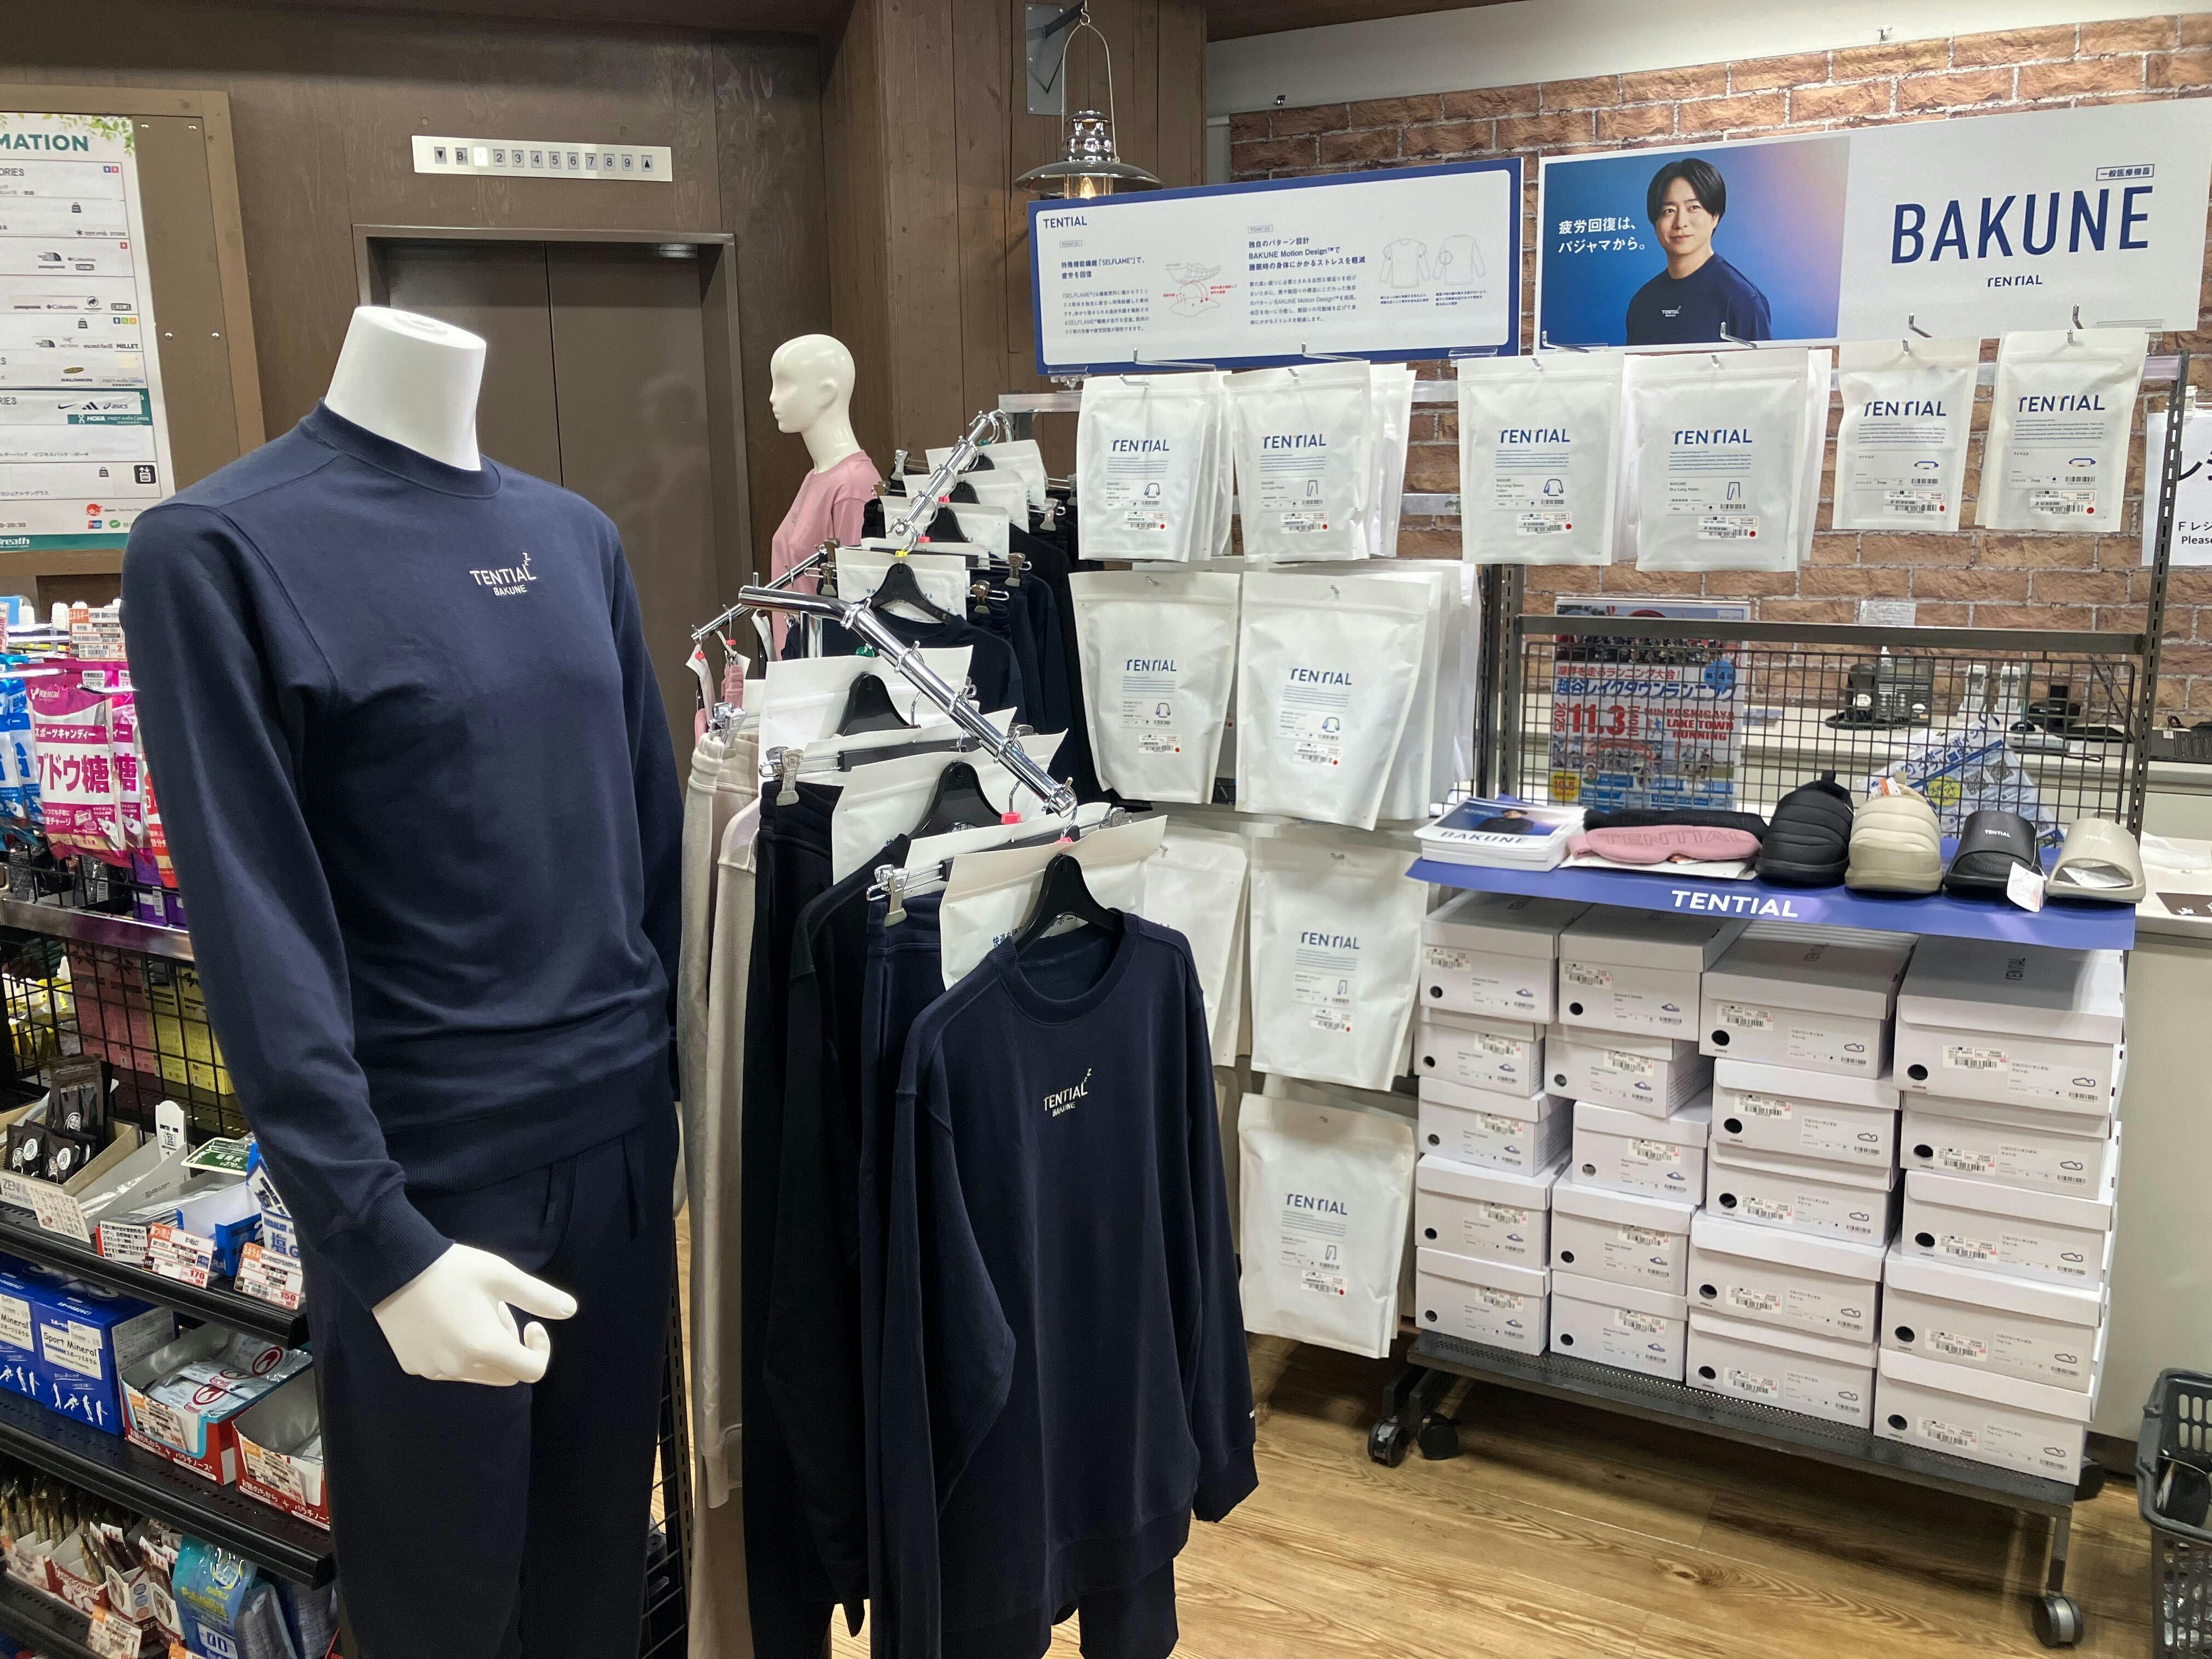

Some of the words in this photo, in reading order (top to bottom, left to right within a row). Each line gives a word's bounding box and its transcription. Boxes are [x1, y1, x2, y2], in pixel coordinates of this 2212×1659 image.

[496, 154, 503, 162] 2
[515, 154, 521, 163] 3
[533, 155, 540, 163] 4
[552, 155, 558, 165] 5
[570, 156, 577, 165] 6
[588, 157, 594, 166] 7
[606, 157, 613, 167] 8
[624, 159, 630, 167] 9
[1043, 216, 1087, 228] TENTIAL
[1559, 217, 1637, 235] 疲労回復は、
[1892, 186, 2153, 264] BAKUNE
[1558, 236, 1646, 254] パジャマから。
[1249, 251, 1278, 259] BAKUNE
[1281, 249, 1303, 257] Motion
[1987, 275, 2043, 287] TENTIAL
[1864, 401, 1946, 417] TENTIAL
[2018, 395, 2106, 412] TENTIAL
[1262, 433, 1327, 449] TENTIAL
[1498, 429, 1570, 443] TENTIAL
[1672, 429, 1752, 444] TENTIAL
[1111, 439, 1170, 452] TENTIAL
[470, 564, 537, 585] TENTIAL
[493, 585, 527, 596] BAKUNE
[1125, 659, 1177, 672] TENTIAL
[1290, 667, 1352, 685] TENTIAL
[1568, 703, 1624, 735] 11.3
[1667, 708, 1735, 719] KOSHIGAYA
[1667, 719, 1694, 728] LAKE
[1699, 720, 1734, 730] TOWN
[1673, 730, 1726, 740] RUNNING
[1598, 830, 1751, 846] TENTIAL
[1985, 830, 2010, 838] TENTIAL
[1672, 890, 1798, 918] TENTIAL
[1300, 932, 1360, 949] TENTIAL
[1043, 1082, 1088, 1111] TENTIAL
[1053, 1102, 1075, 1117] BAKUNE
[1286, 1193, 1347, 1215] TENTIAL
[190, 1271, 205, 1279] 170
[280, 1292, 296, 1301] 150
[1, 1314, 28, 1329] Mineral
[44, 1332, 64, 1345] Sport
[67, 1340, 97, 1357] Mineral
